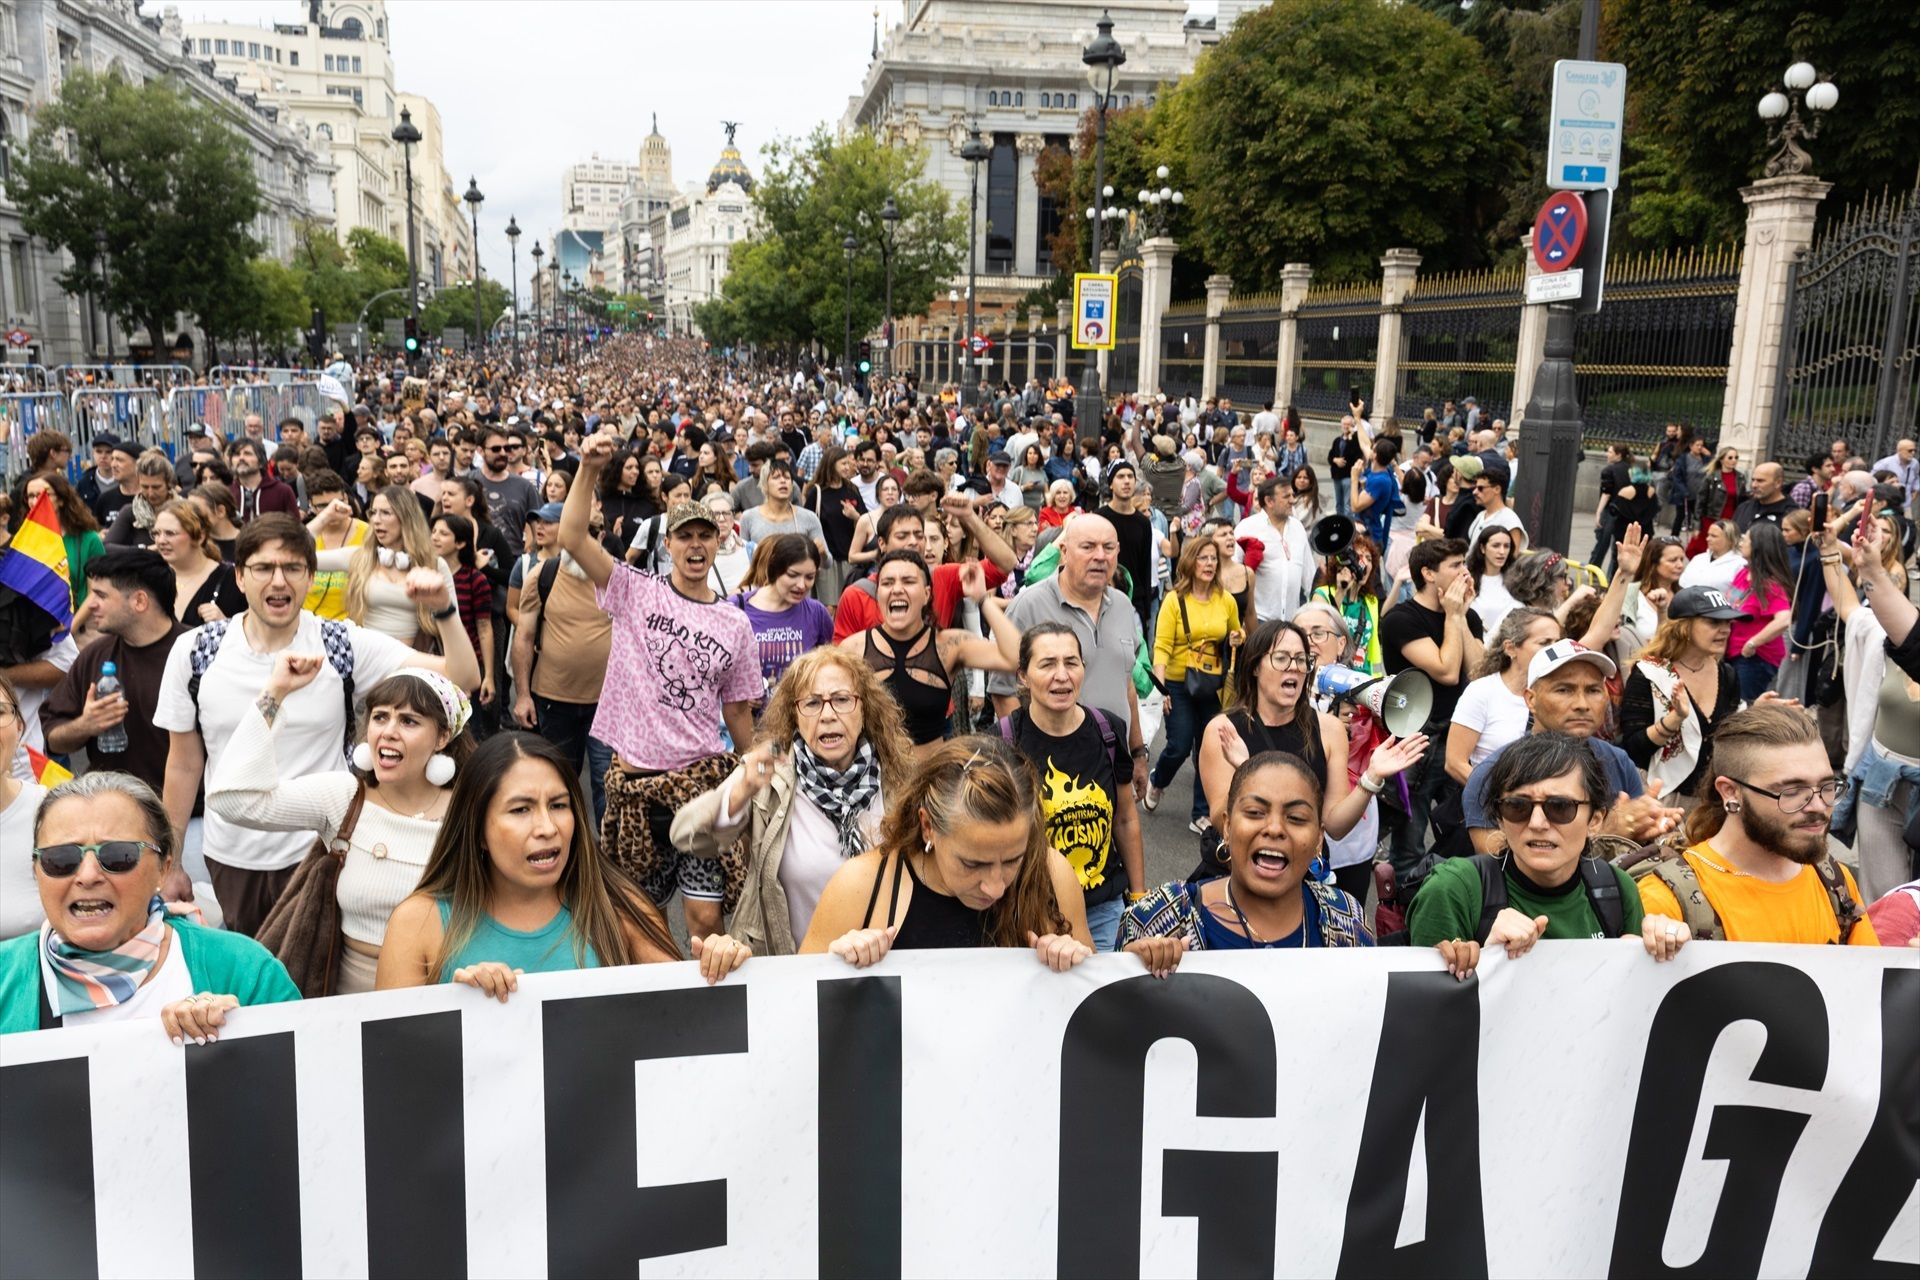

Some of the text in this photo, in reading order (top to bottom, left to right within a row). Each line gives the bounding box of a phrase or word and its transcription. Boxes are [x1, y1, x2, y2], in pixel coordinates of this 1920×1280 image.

[1703, 591, 1730, 607] TR
[693, 631, 733, 672] KITTY
[1063, 809, 1099, 822] RENTISMO
[0, 971, 1489, 1280] UELGA
